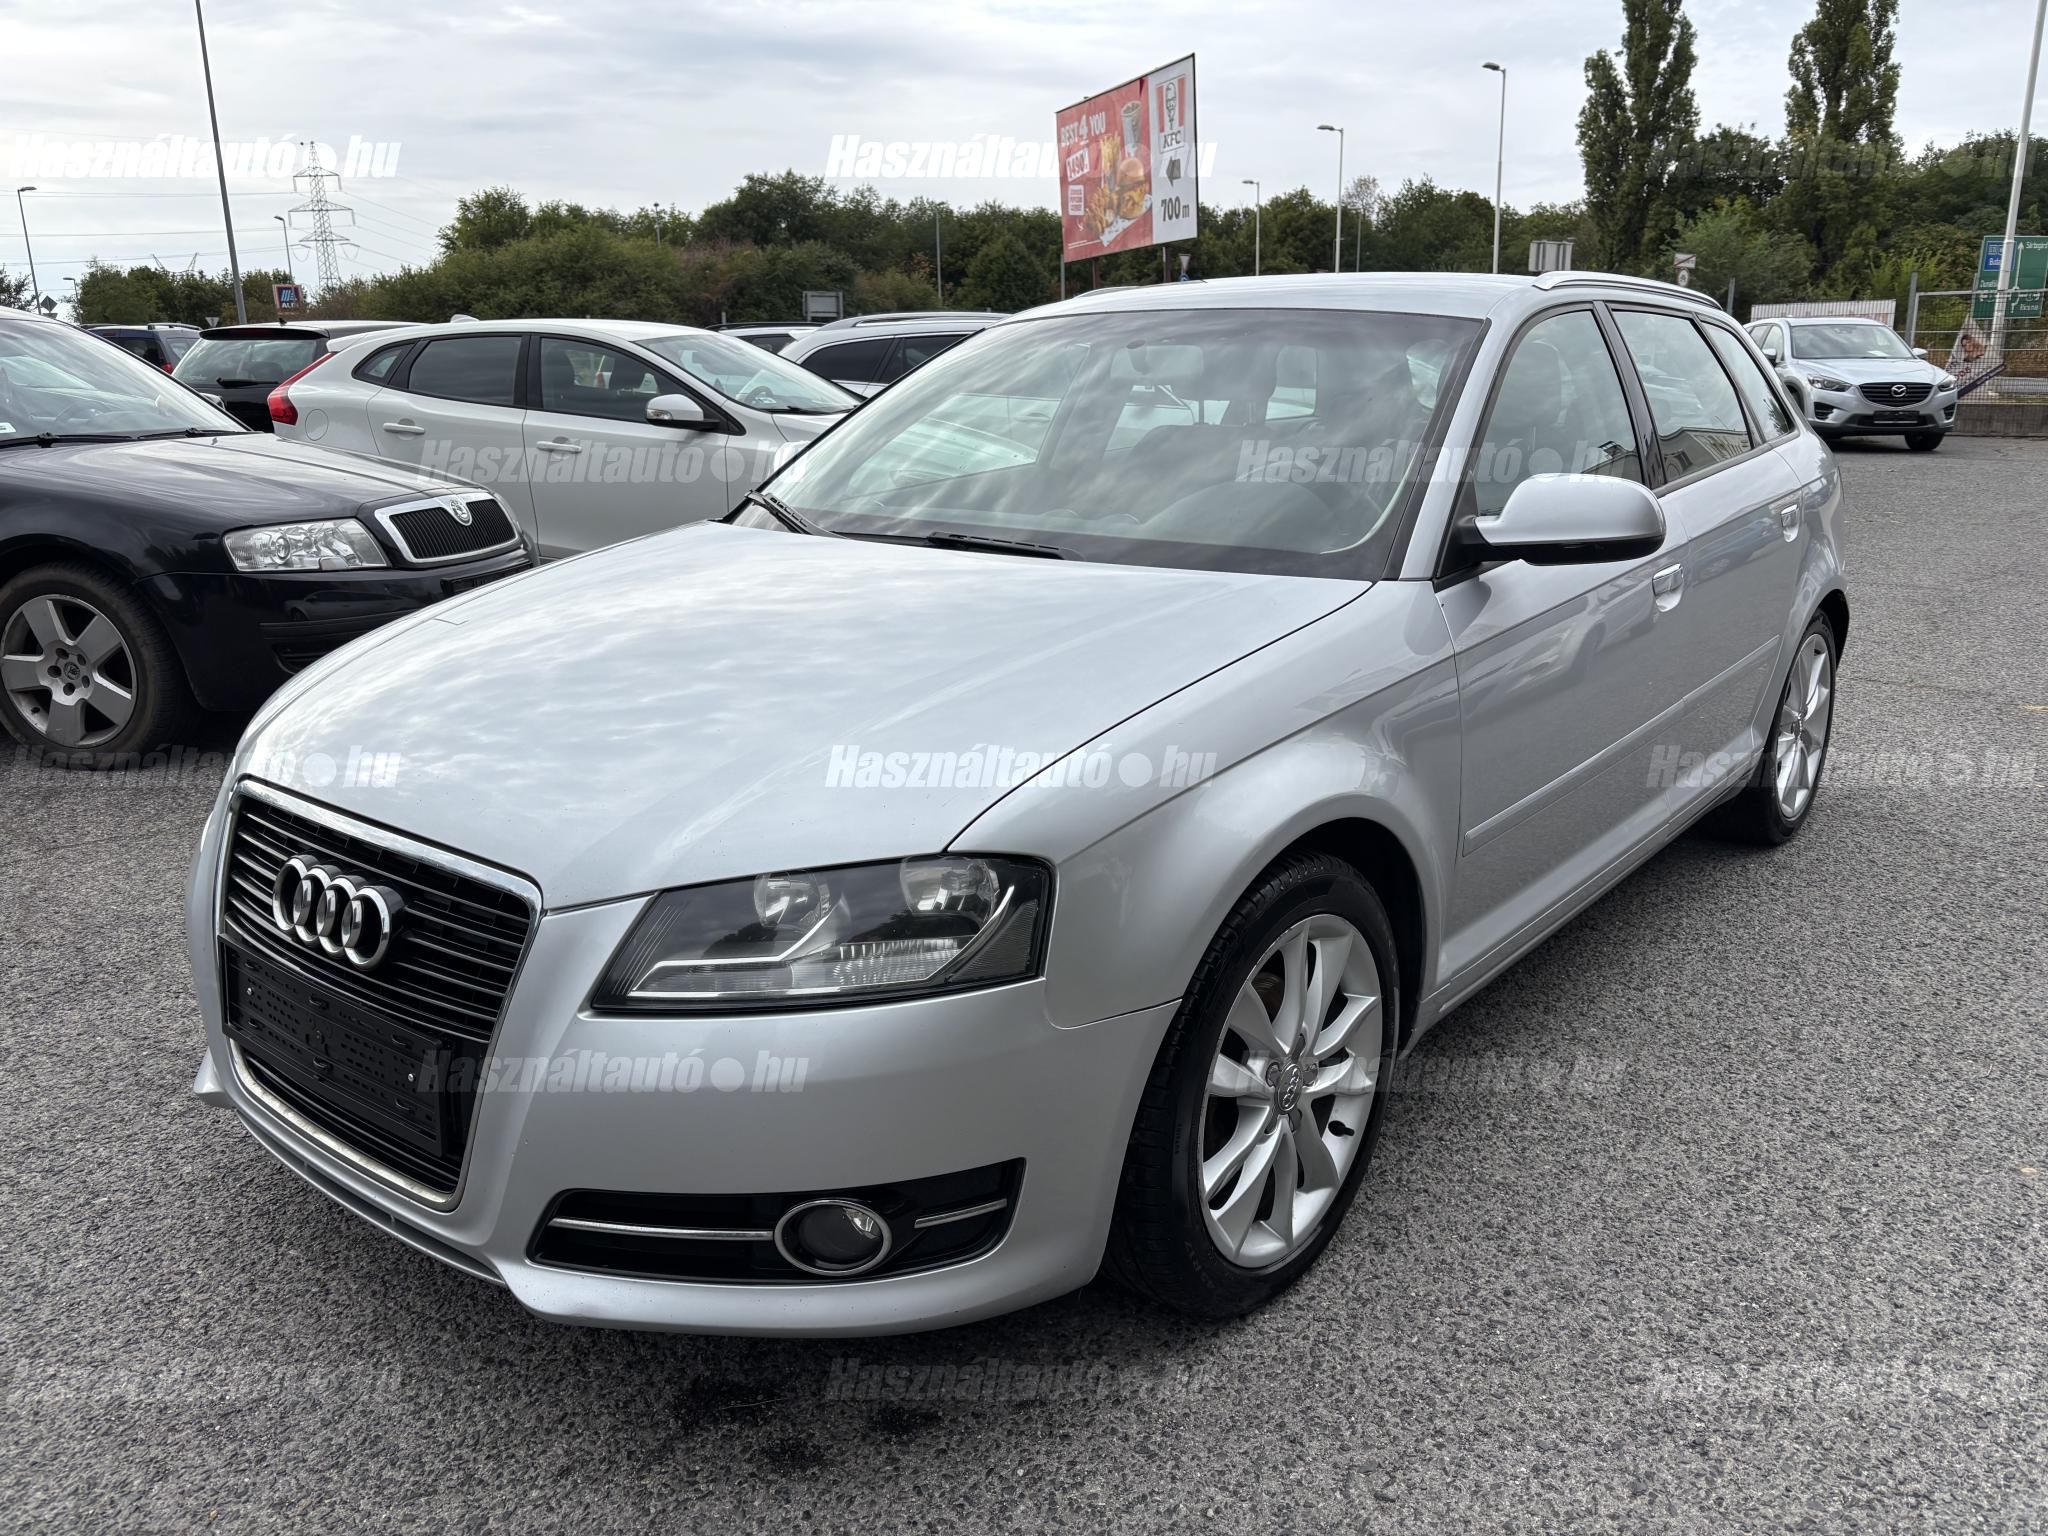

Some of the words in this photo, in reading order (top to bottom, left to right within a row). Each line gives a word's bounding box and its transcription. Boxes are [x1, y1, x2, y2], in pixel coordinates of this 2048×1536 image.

[1061, 123, 1079, 146] BEST
[1079, 114, 1089, 142] 4
[1089, 111, 1106, 136] YOU
[1163, 131, 1181, 149] KFC
[1161, 195, 1181, 222] 700
[1182, 205, 1190, 218] m
